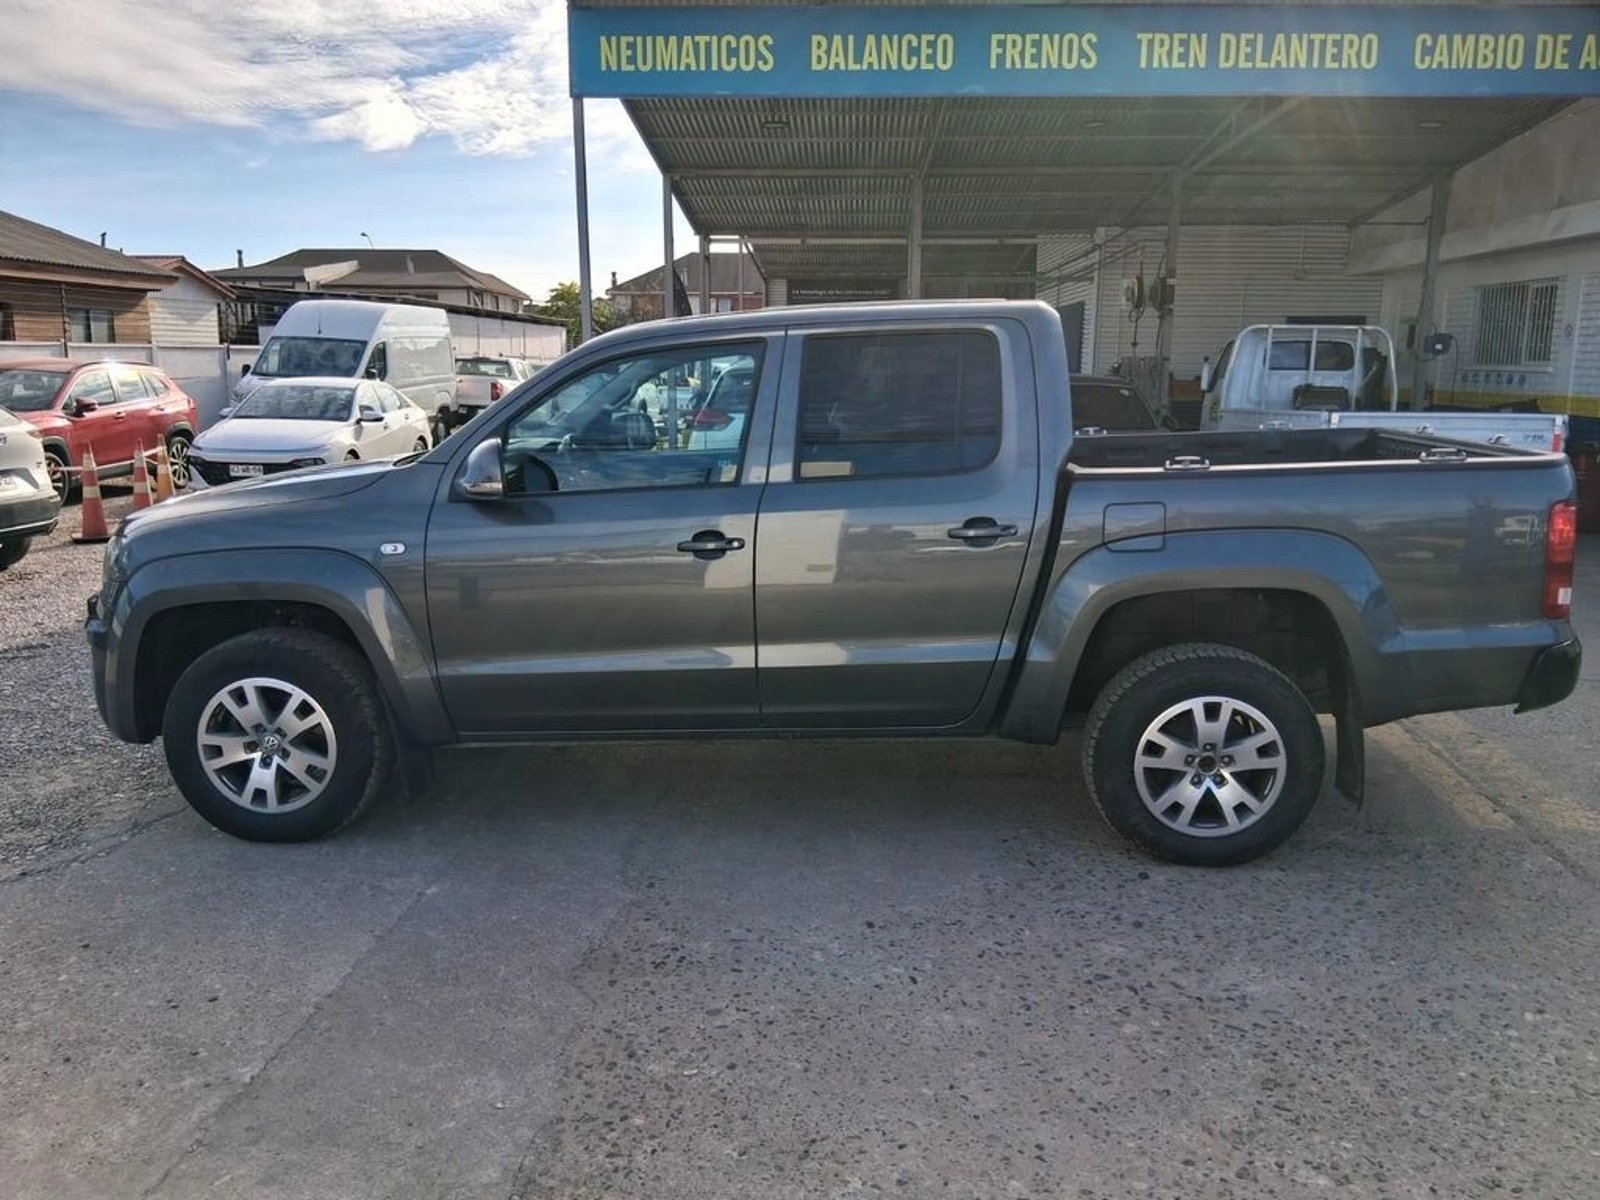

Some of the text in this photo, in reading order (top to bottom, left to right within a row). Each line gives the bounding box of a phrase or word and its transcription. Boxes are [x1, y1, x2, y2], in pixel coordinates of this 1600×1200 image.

[600, 35, 774, 72] NEUMATICOS
[811, 34, 954, 71] BALANCEO
[989, 33, 1098, 70] FRENOS
[1137, 33, 1378, 70] TREN DELANTERO
[1414, 33, 1600, 70] CAMBIO DE A
